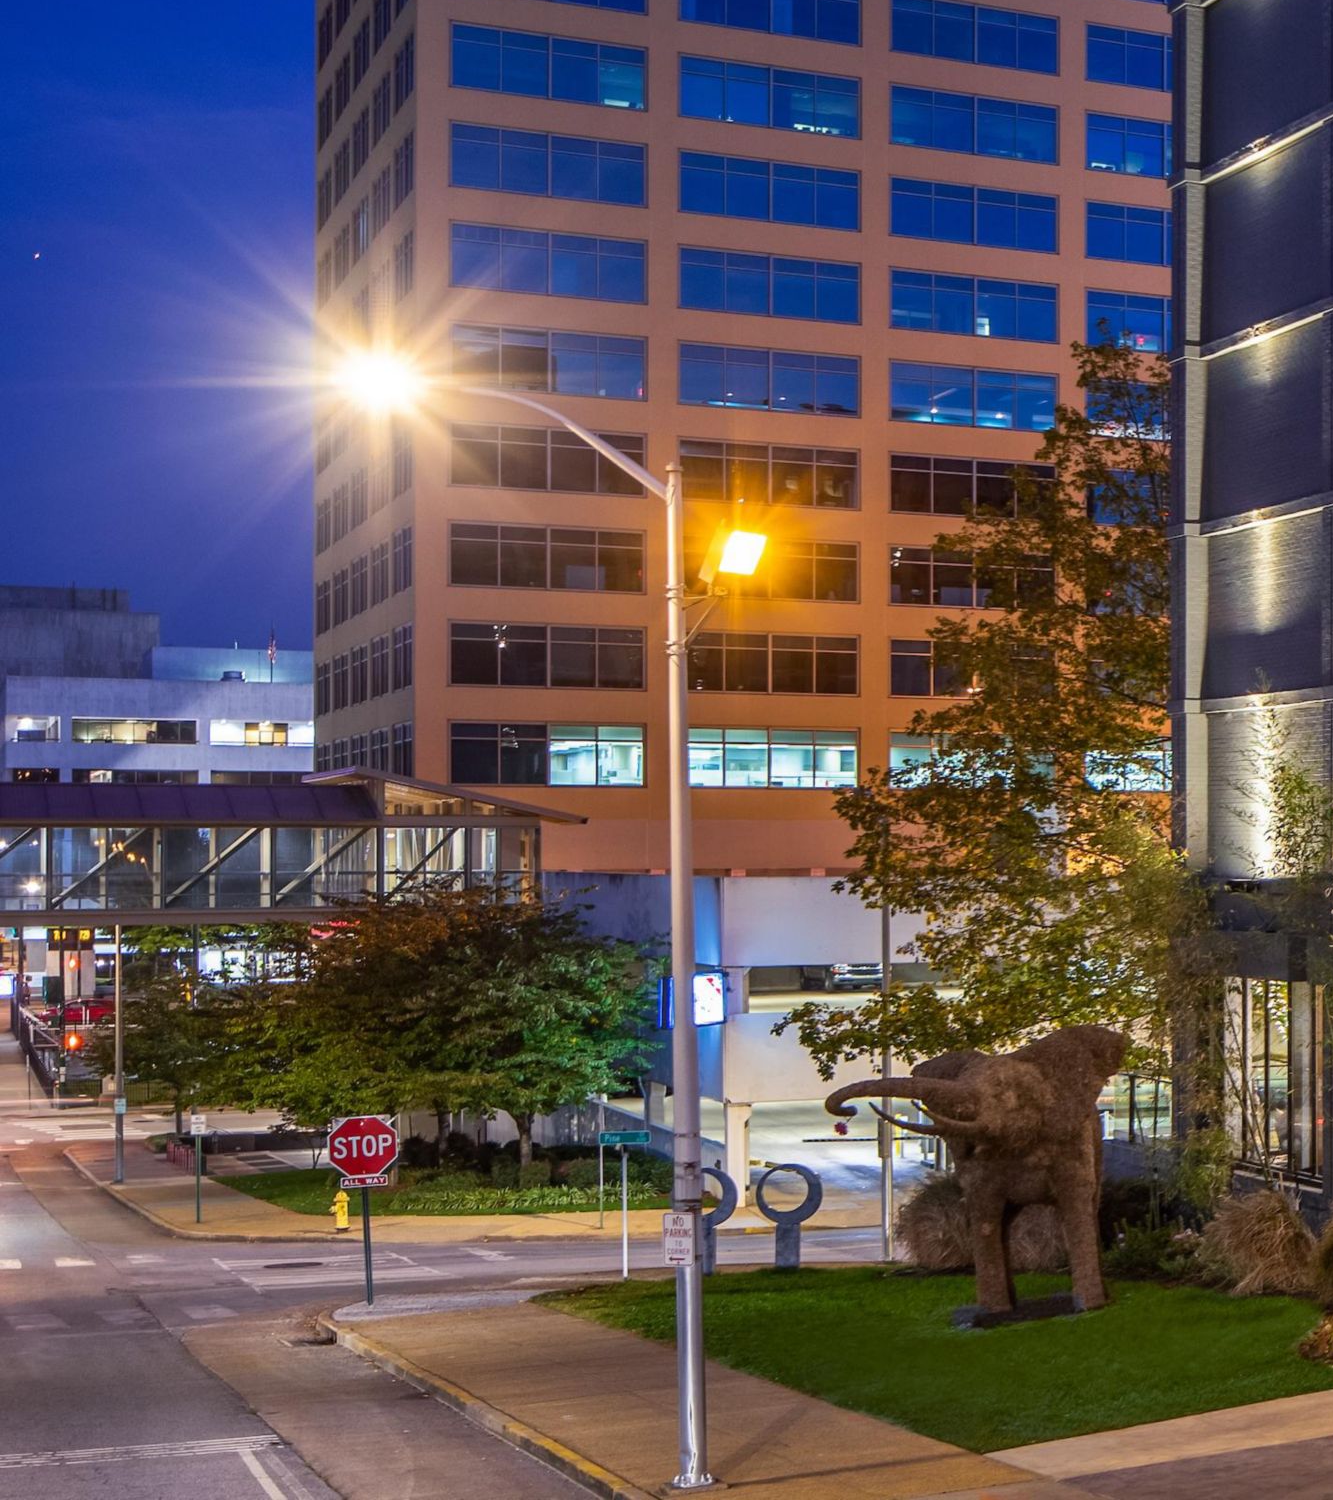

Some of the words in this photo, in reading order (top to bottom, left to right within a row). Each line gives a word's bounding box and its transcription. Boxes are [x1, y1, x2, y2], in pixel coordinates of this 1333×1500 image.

[333, 1134, 392, 1159] STOP
[365, 1177, 385, 1185] WAY
[672, 1217, 684, 1227] NO
[664, 1228, 692, 1238] PARKING
